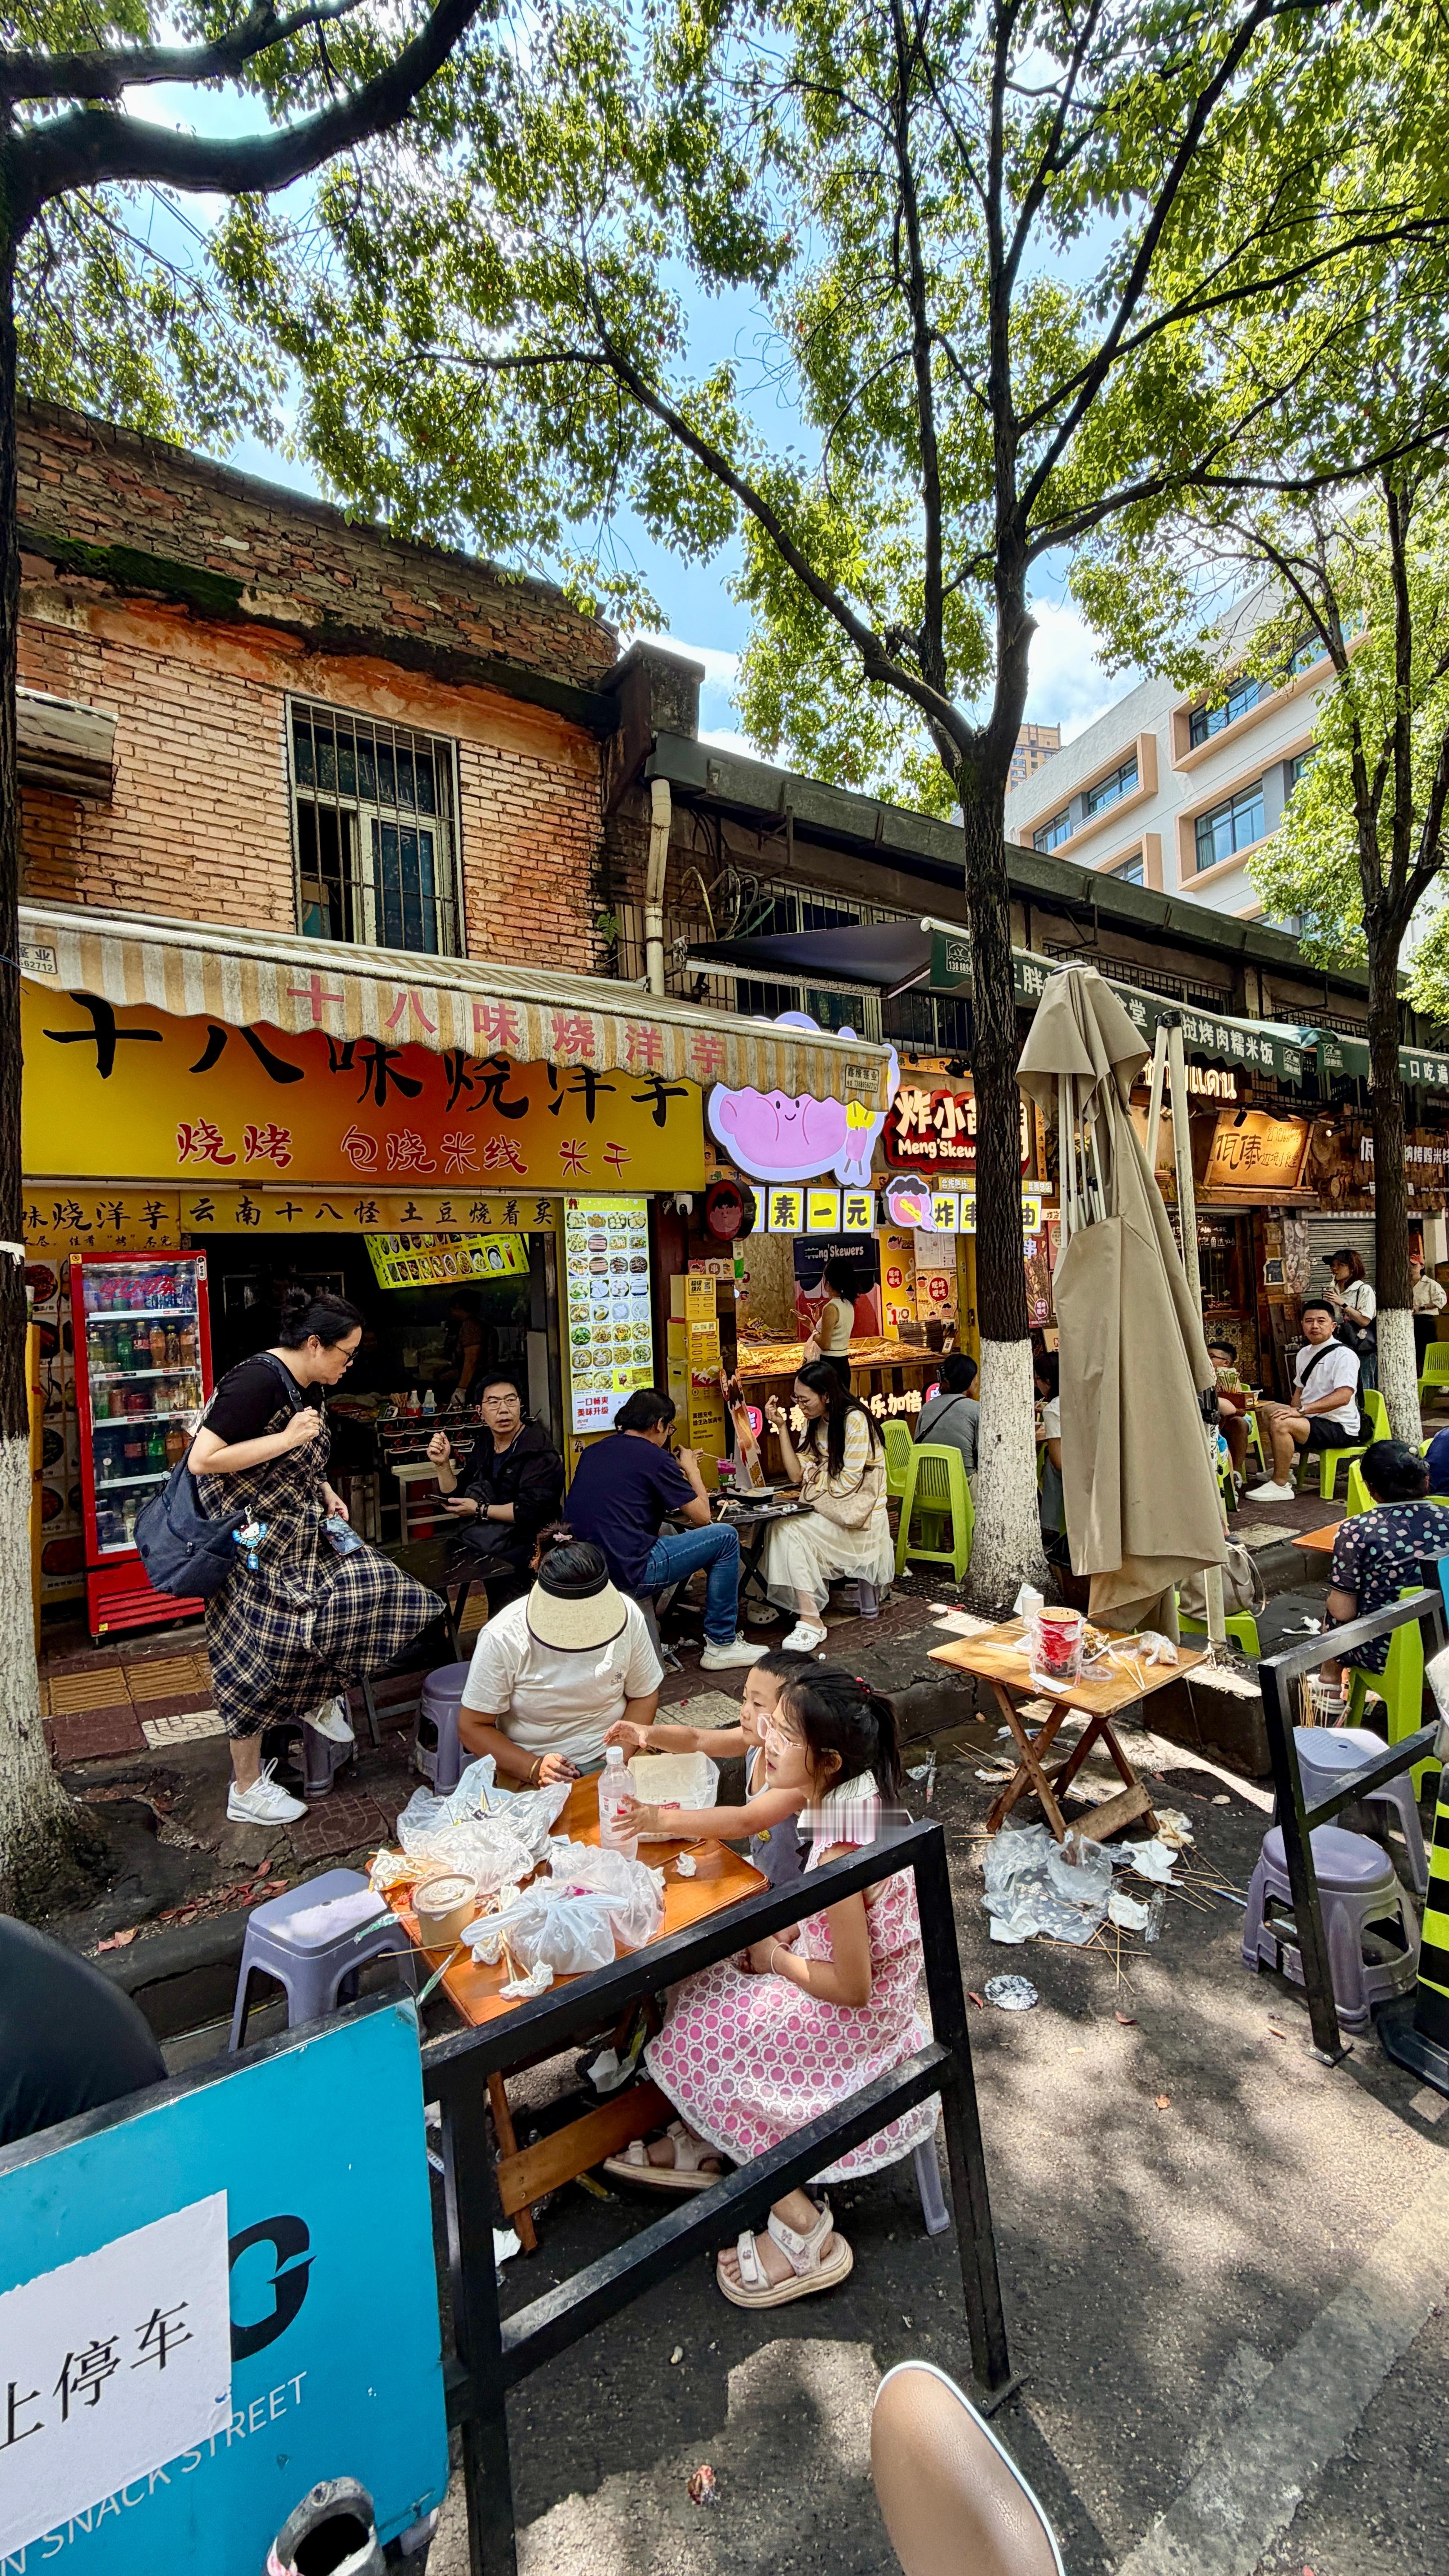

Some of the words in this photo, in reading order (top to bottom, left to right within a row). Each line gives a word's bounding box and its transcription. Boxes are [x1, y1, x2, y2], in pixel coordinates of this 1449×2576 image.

[287, 975, 725, 1074] 十八味烧洋芋
[177, 1118, 292, 1168] 烧烤
[341, 1125, 528, 1175] 包烧米线
[558, 1138, 632, 1178] 米干
[189, 1195, 553, 1226] 云南十八怪土豆烧着卖
